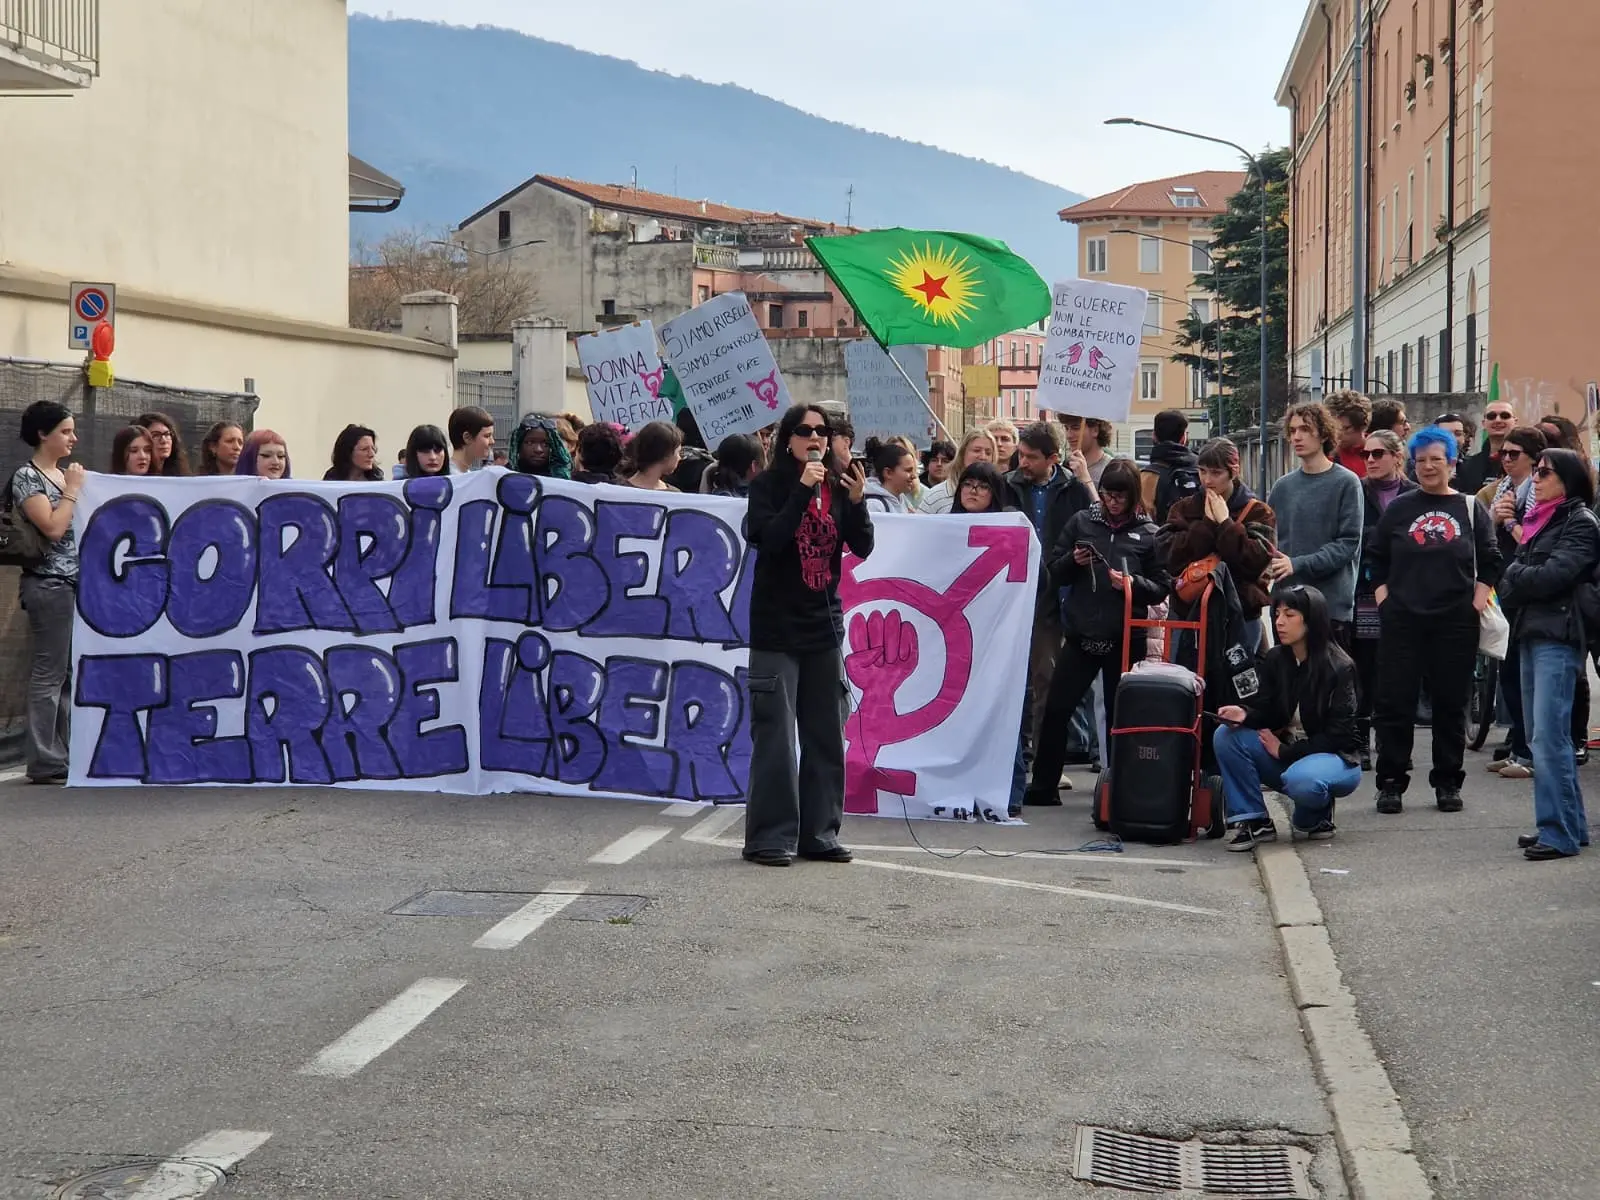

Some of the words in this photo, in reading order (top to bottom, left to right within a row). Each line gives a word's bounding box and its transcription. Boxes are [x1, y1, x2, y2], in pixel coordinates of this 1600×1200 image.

[1055, 293, 1069, 306] LE
[1074, 295, 1127, 316] GUERRE
[1054, 311, 1074, 323] NON
[1080, 316, 1093, 326] LE
[662, 321, 714, 359] SIAMO
[713, 304, 750, 332] RIBELLI
[1050, 326, 1135, 346] COMBATTEREMO
[587, 350, 648, 385] DONNA
[678, 355, 709, 379] SIAMO
[1061, 364, 1112, 381] EDUCAZIONE
[594, 381, 641, 407] VITA
[1054, 377, 1112, 393] DEDICHEREMO
[707, 386, 737, 407] MIMOSE
[75, 636, 470, 784] TERRE
[1138, 746, 1160, 760] JBL
